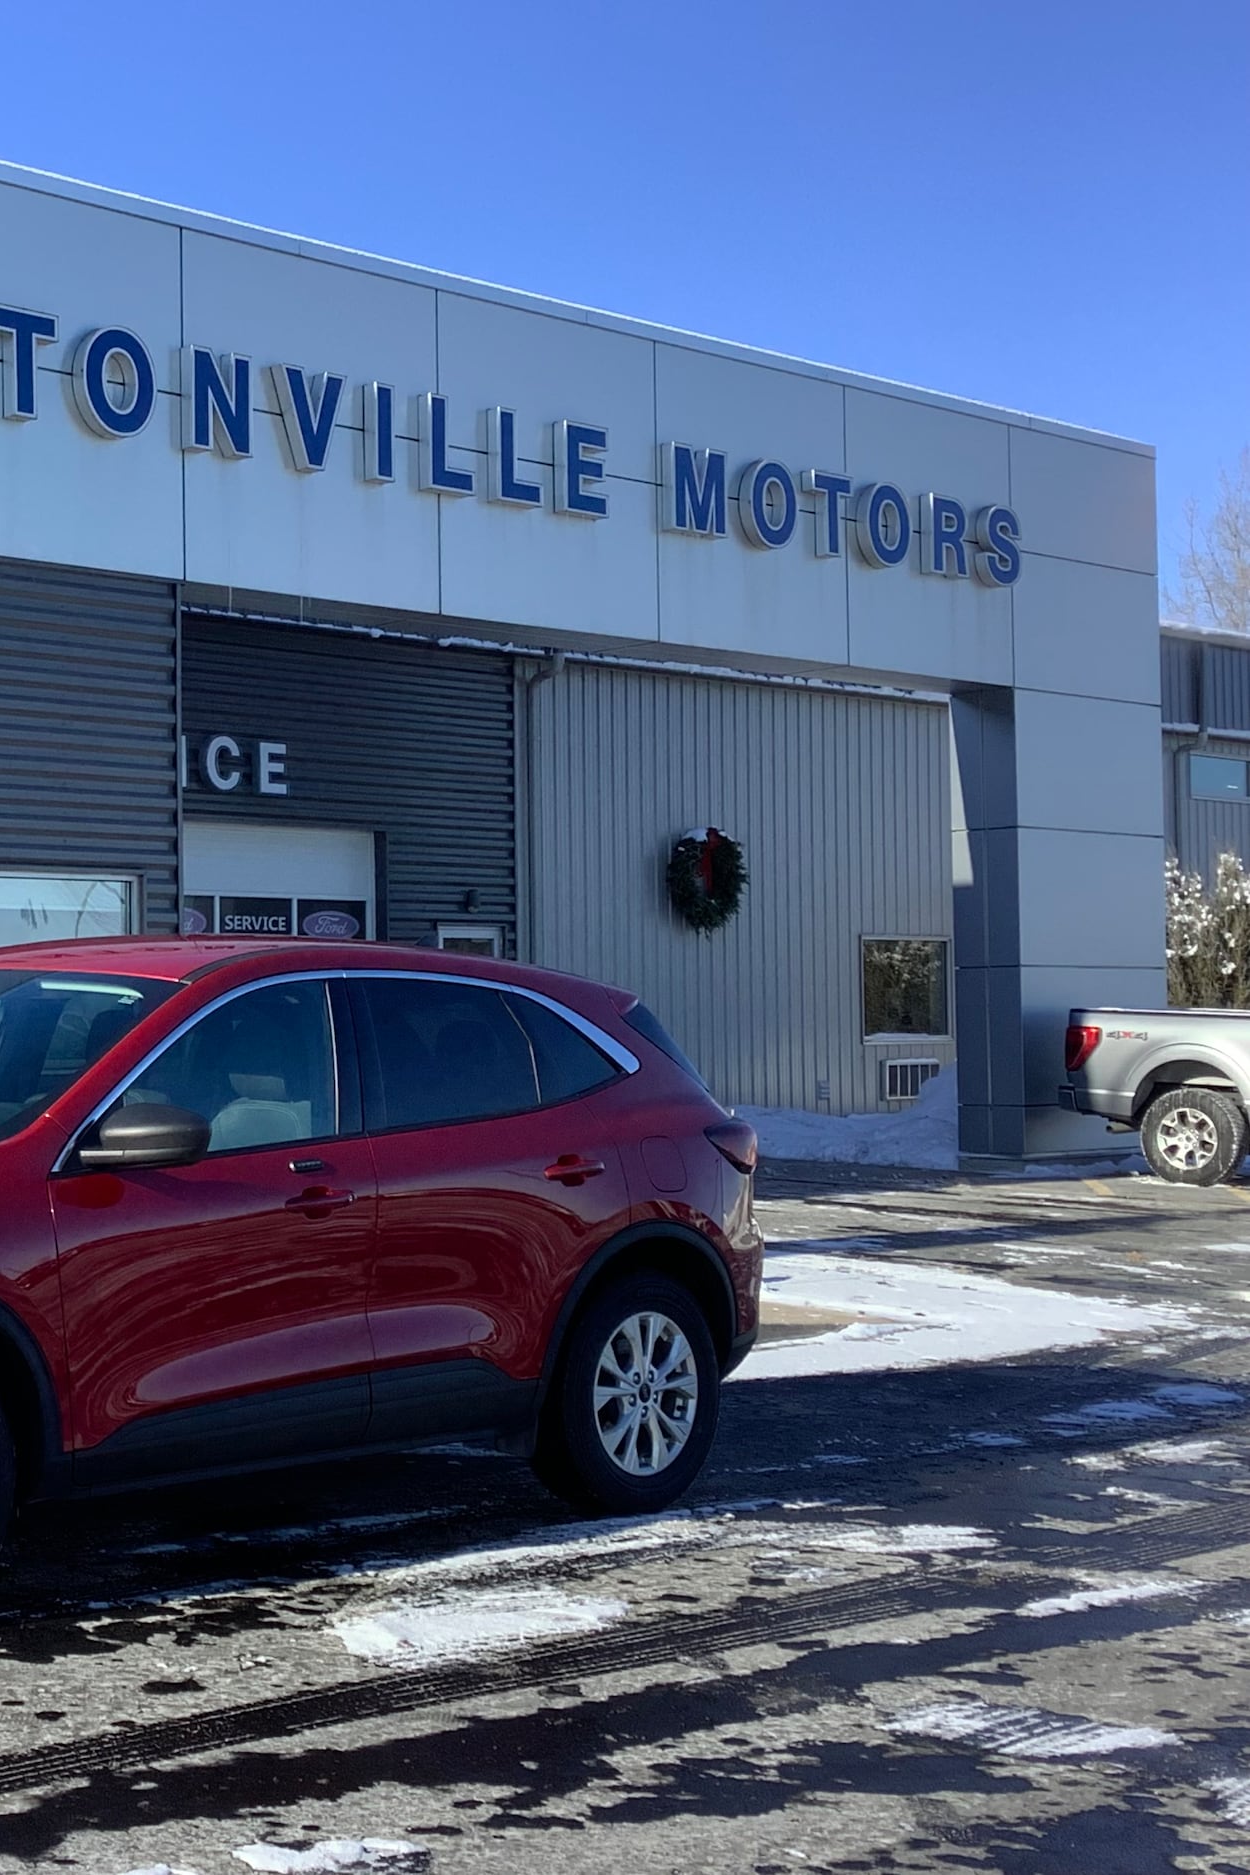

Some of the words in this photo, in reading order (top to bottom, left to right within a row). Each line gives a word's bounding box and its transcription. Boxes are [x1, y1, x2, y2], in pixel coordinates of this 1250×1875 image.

[661, 440, 1022, 588] MOTORS
[224, 914, 287, 932] SERVICE
[314, 915, 348, 935] Ford
